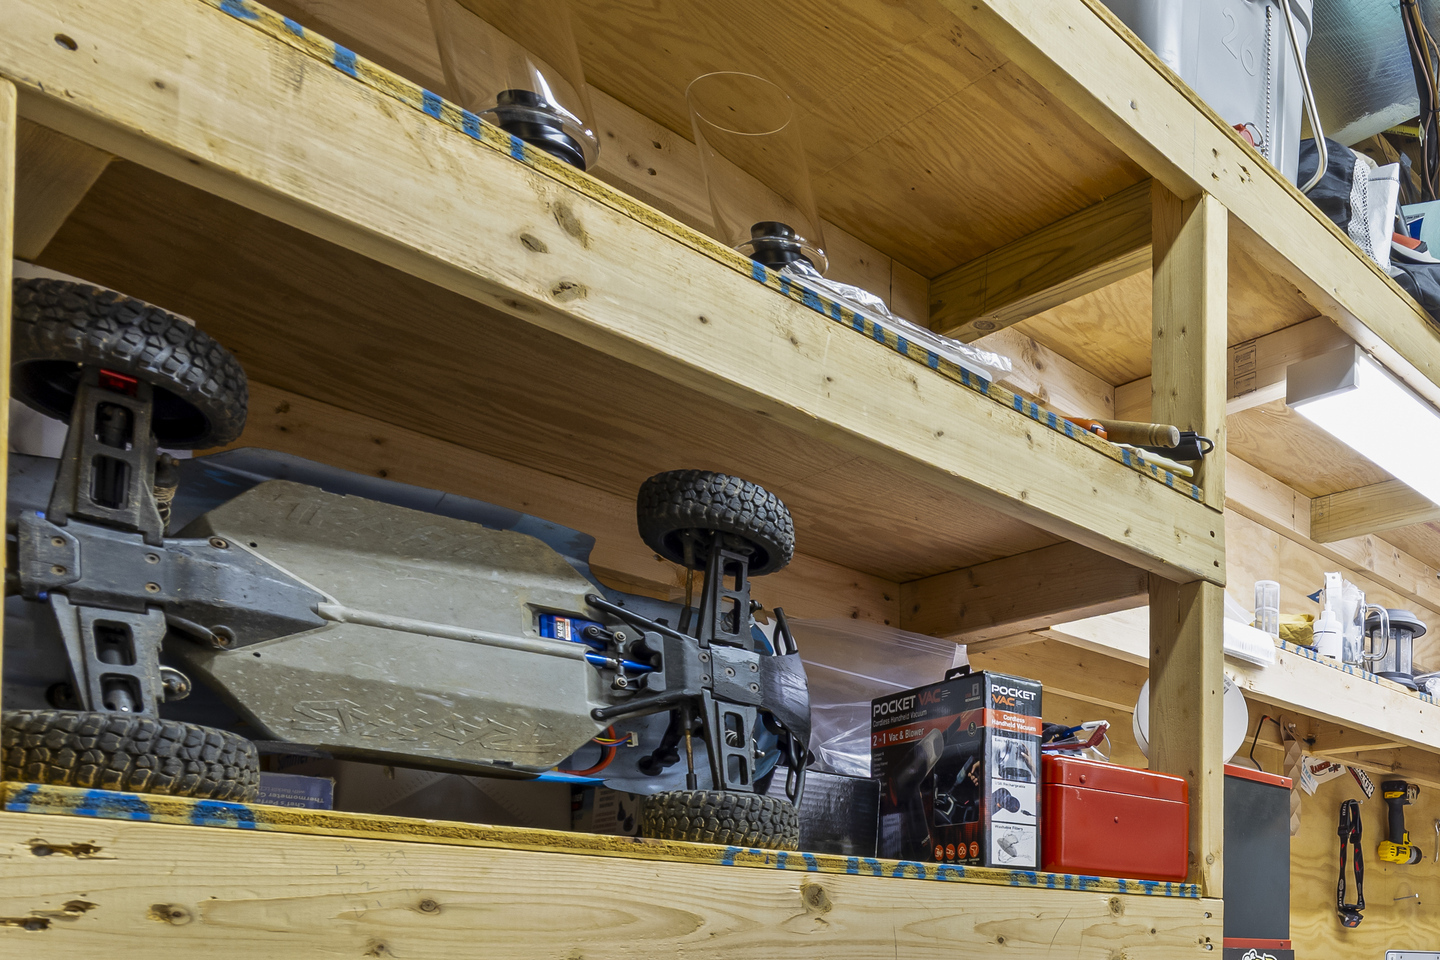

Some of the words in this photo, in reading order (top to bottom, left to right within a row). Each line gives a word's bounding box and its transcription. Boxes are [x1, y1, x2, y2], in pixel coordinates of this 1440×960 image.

[991, 683, 1037, 701] POCKET
[873, 695, 916, 717] POCKET
[918, 689, 941, 706] VAC
[991, 694, 1016, 707] VAC
[873, 716, 890, 728] Cordless
[891, 713, 910, 723] Handheld
[910, 709, 928, 720] Vacuum
[1002, 714, 1026, 724] Cordless
[991, 719, 1016, 730] Handheld
[1016, 721, 1037, 732] Vacuum
[889, 730, 899, 742] Vac
[900, 730, 904, 739] &
[904, 727, 925, 739] Blower
[268, 792, 324, 804] Thermometer
[280, 800, 306, 808] Chef's
